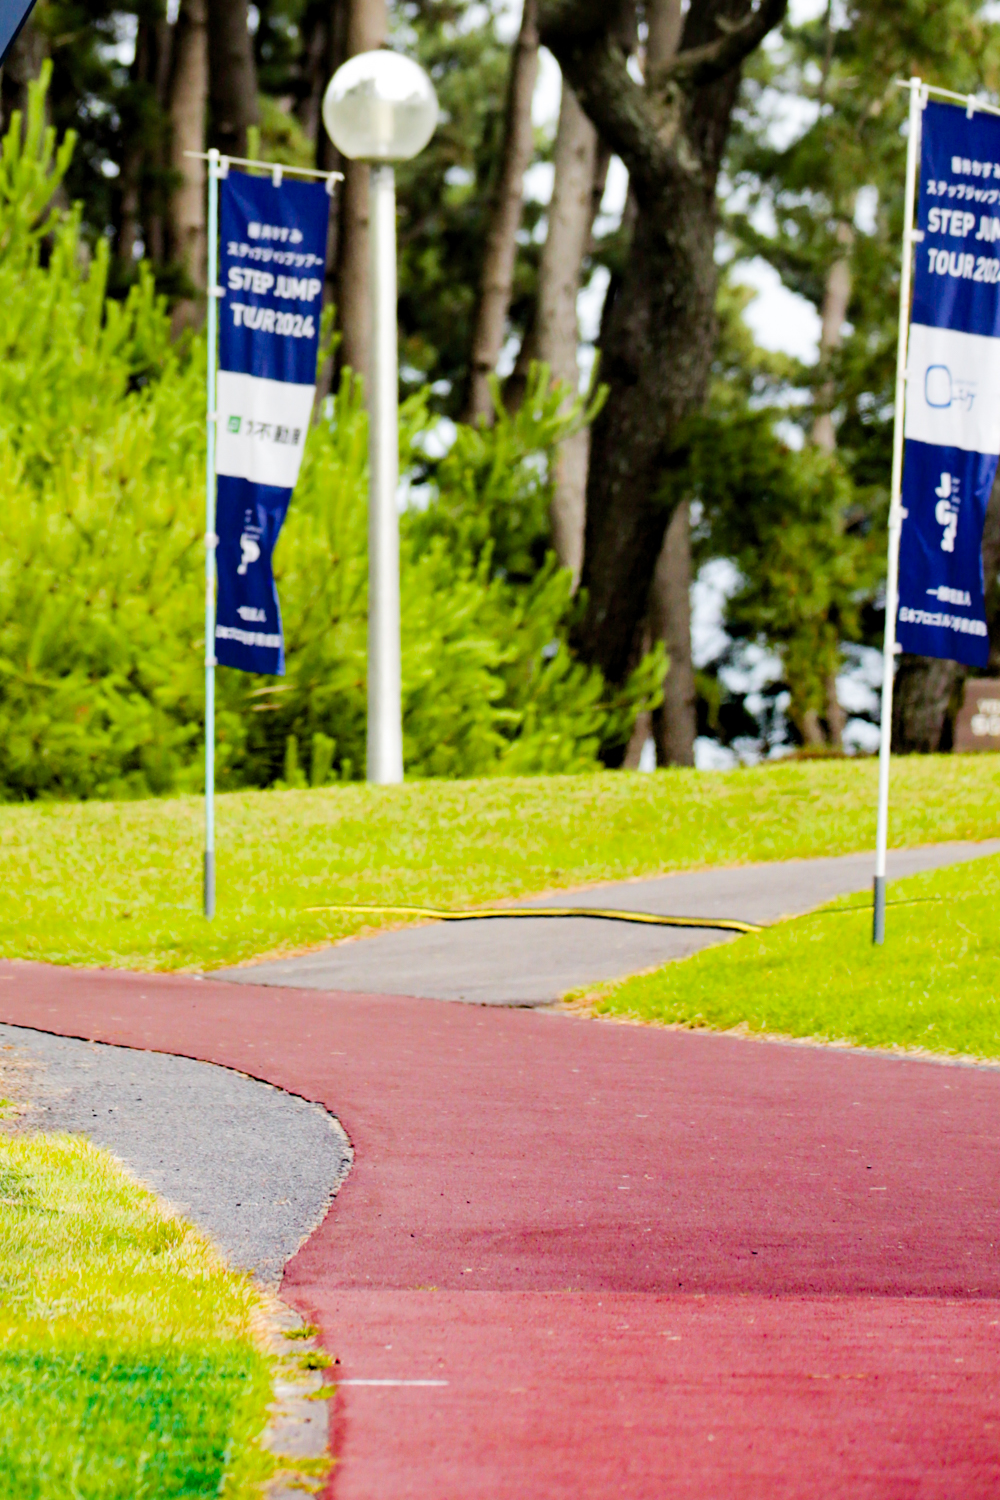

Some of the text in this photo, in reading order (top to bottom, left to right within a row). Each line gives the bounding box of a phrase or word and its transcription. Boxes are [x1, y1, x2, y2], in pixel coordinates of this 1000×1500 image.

[927, 207, 975, 238] STEP
[227, 266, 322, 302] STEP JUMP
